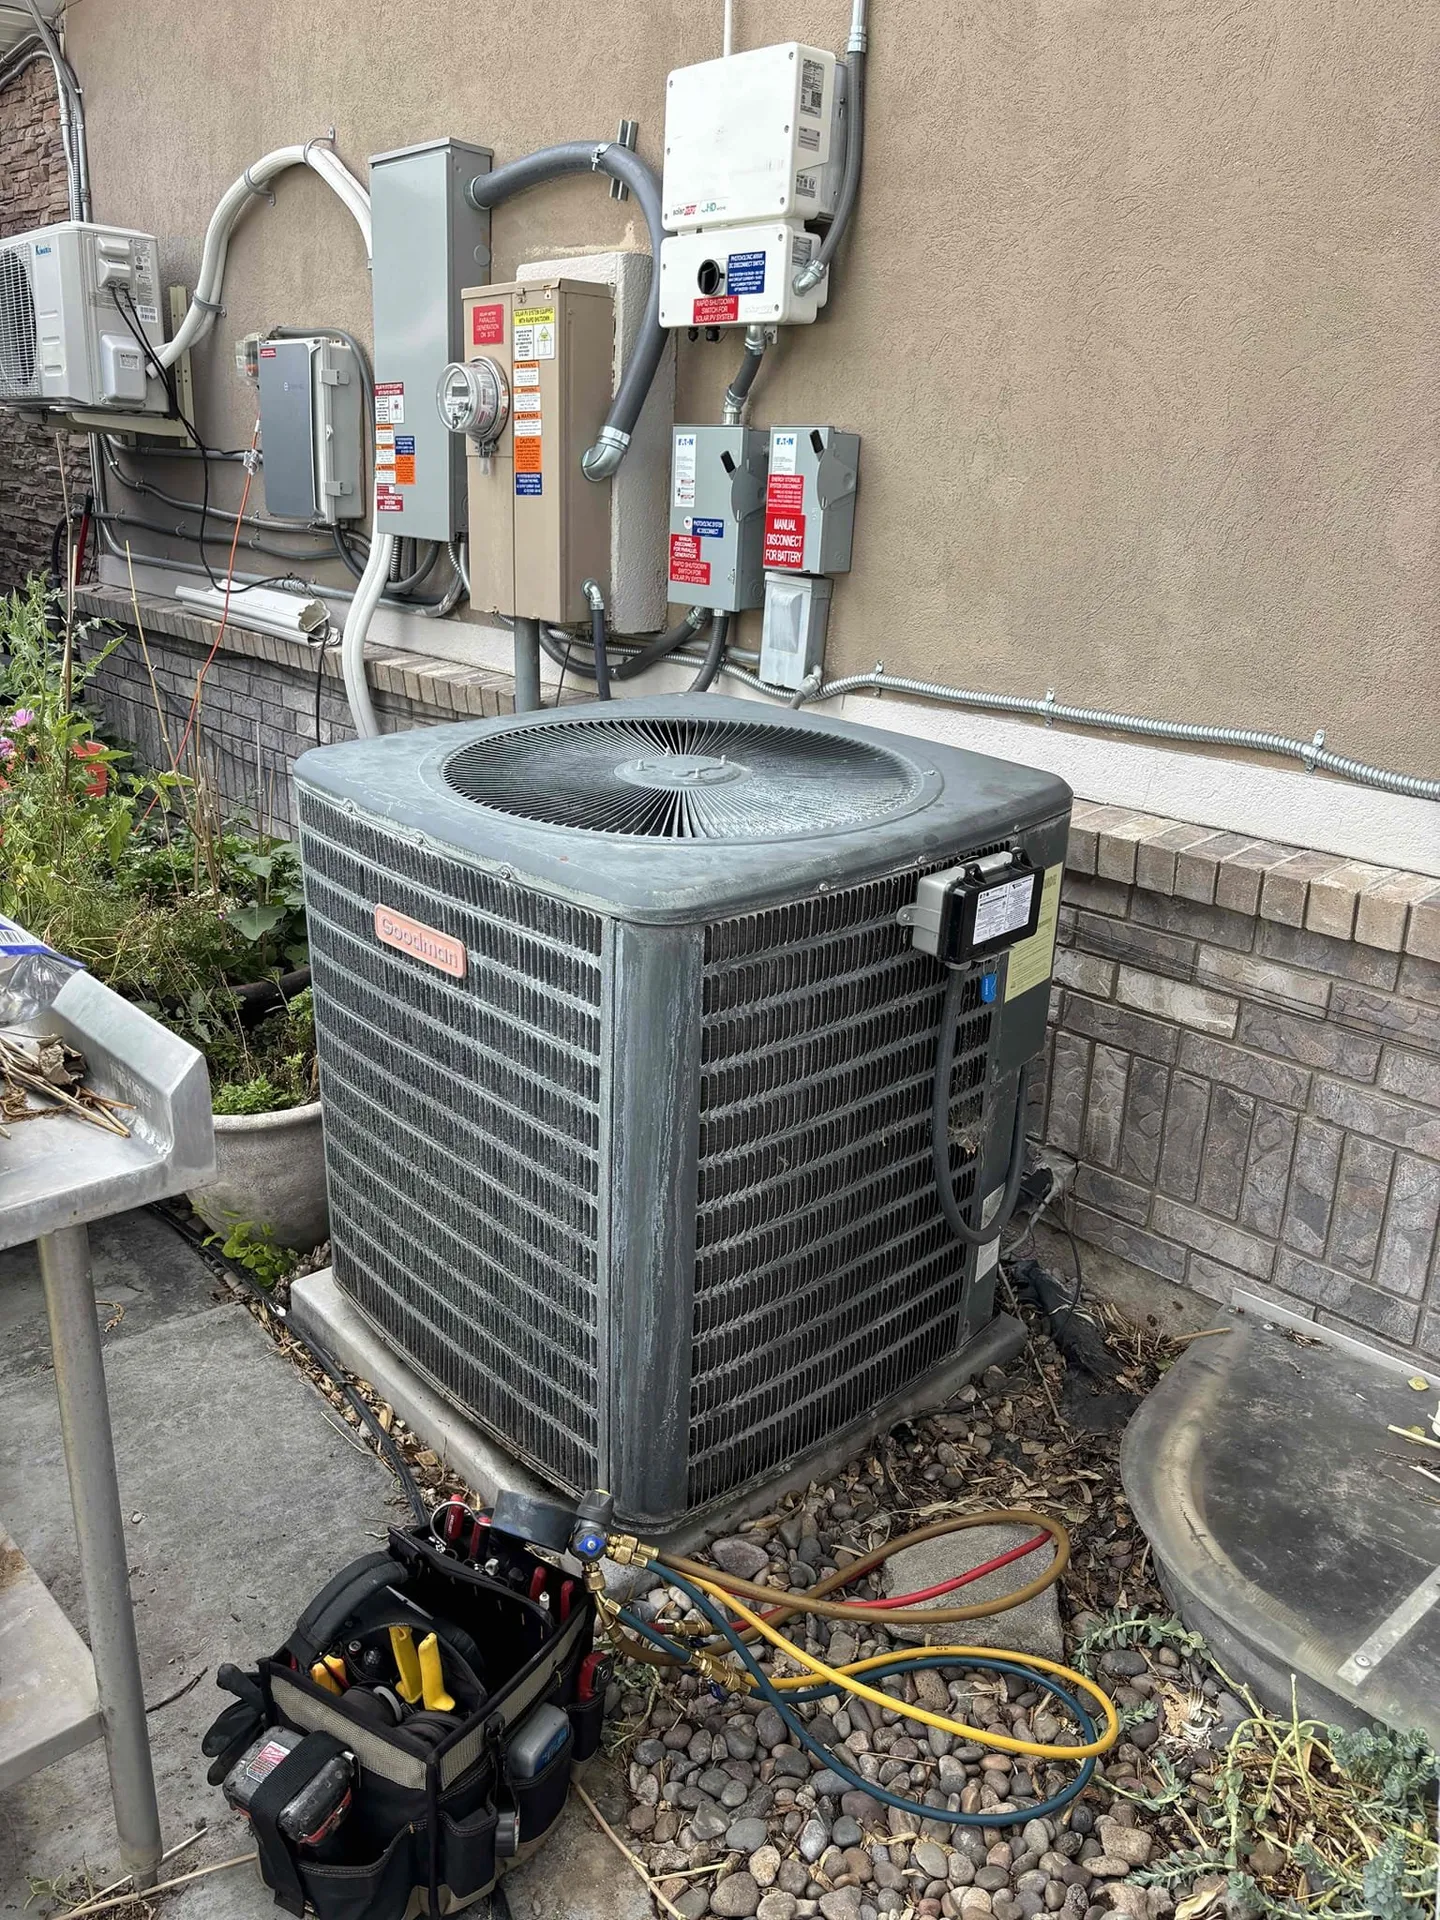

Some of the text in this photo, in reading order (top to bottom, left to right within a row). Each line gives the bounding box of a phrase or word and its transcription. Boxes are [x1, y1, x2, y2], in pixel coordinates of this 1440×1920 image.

[774, 518, 796, 531] MANUAL
[766, 533, 803, 547] DISCONNECT
[765, 549, 803, 563] FOR BATTERY
[382, 916, 458, 968] Goodman
